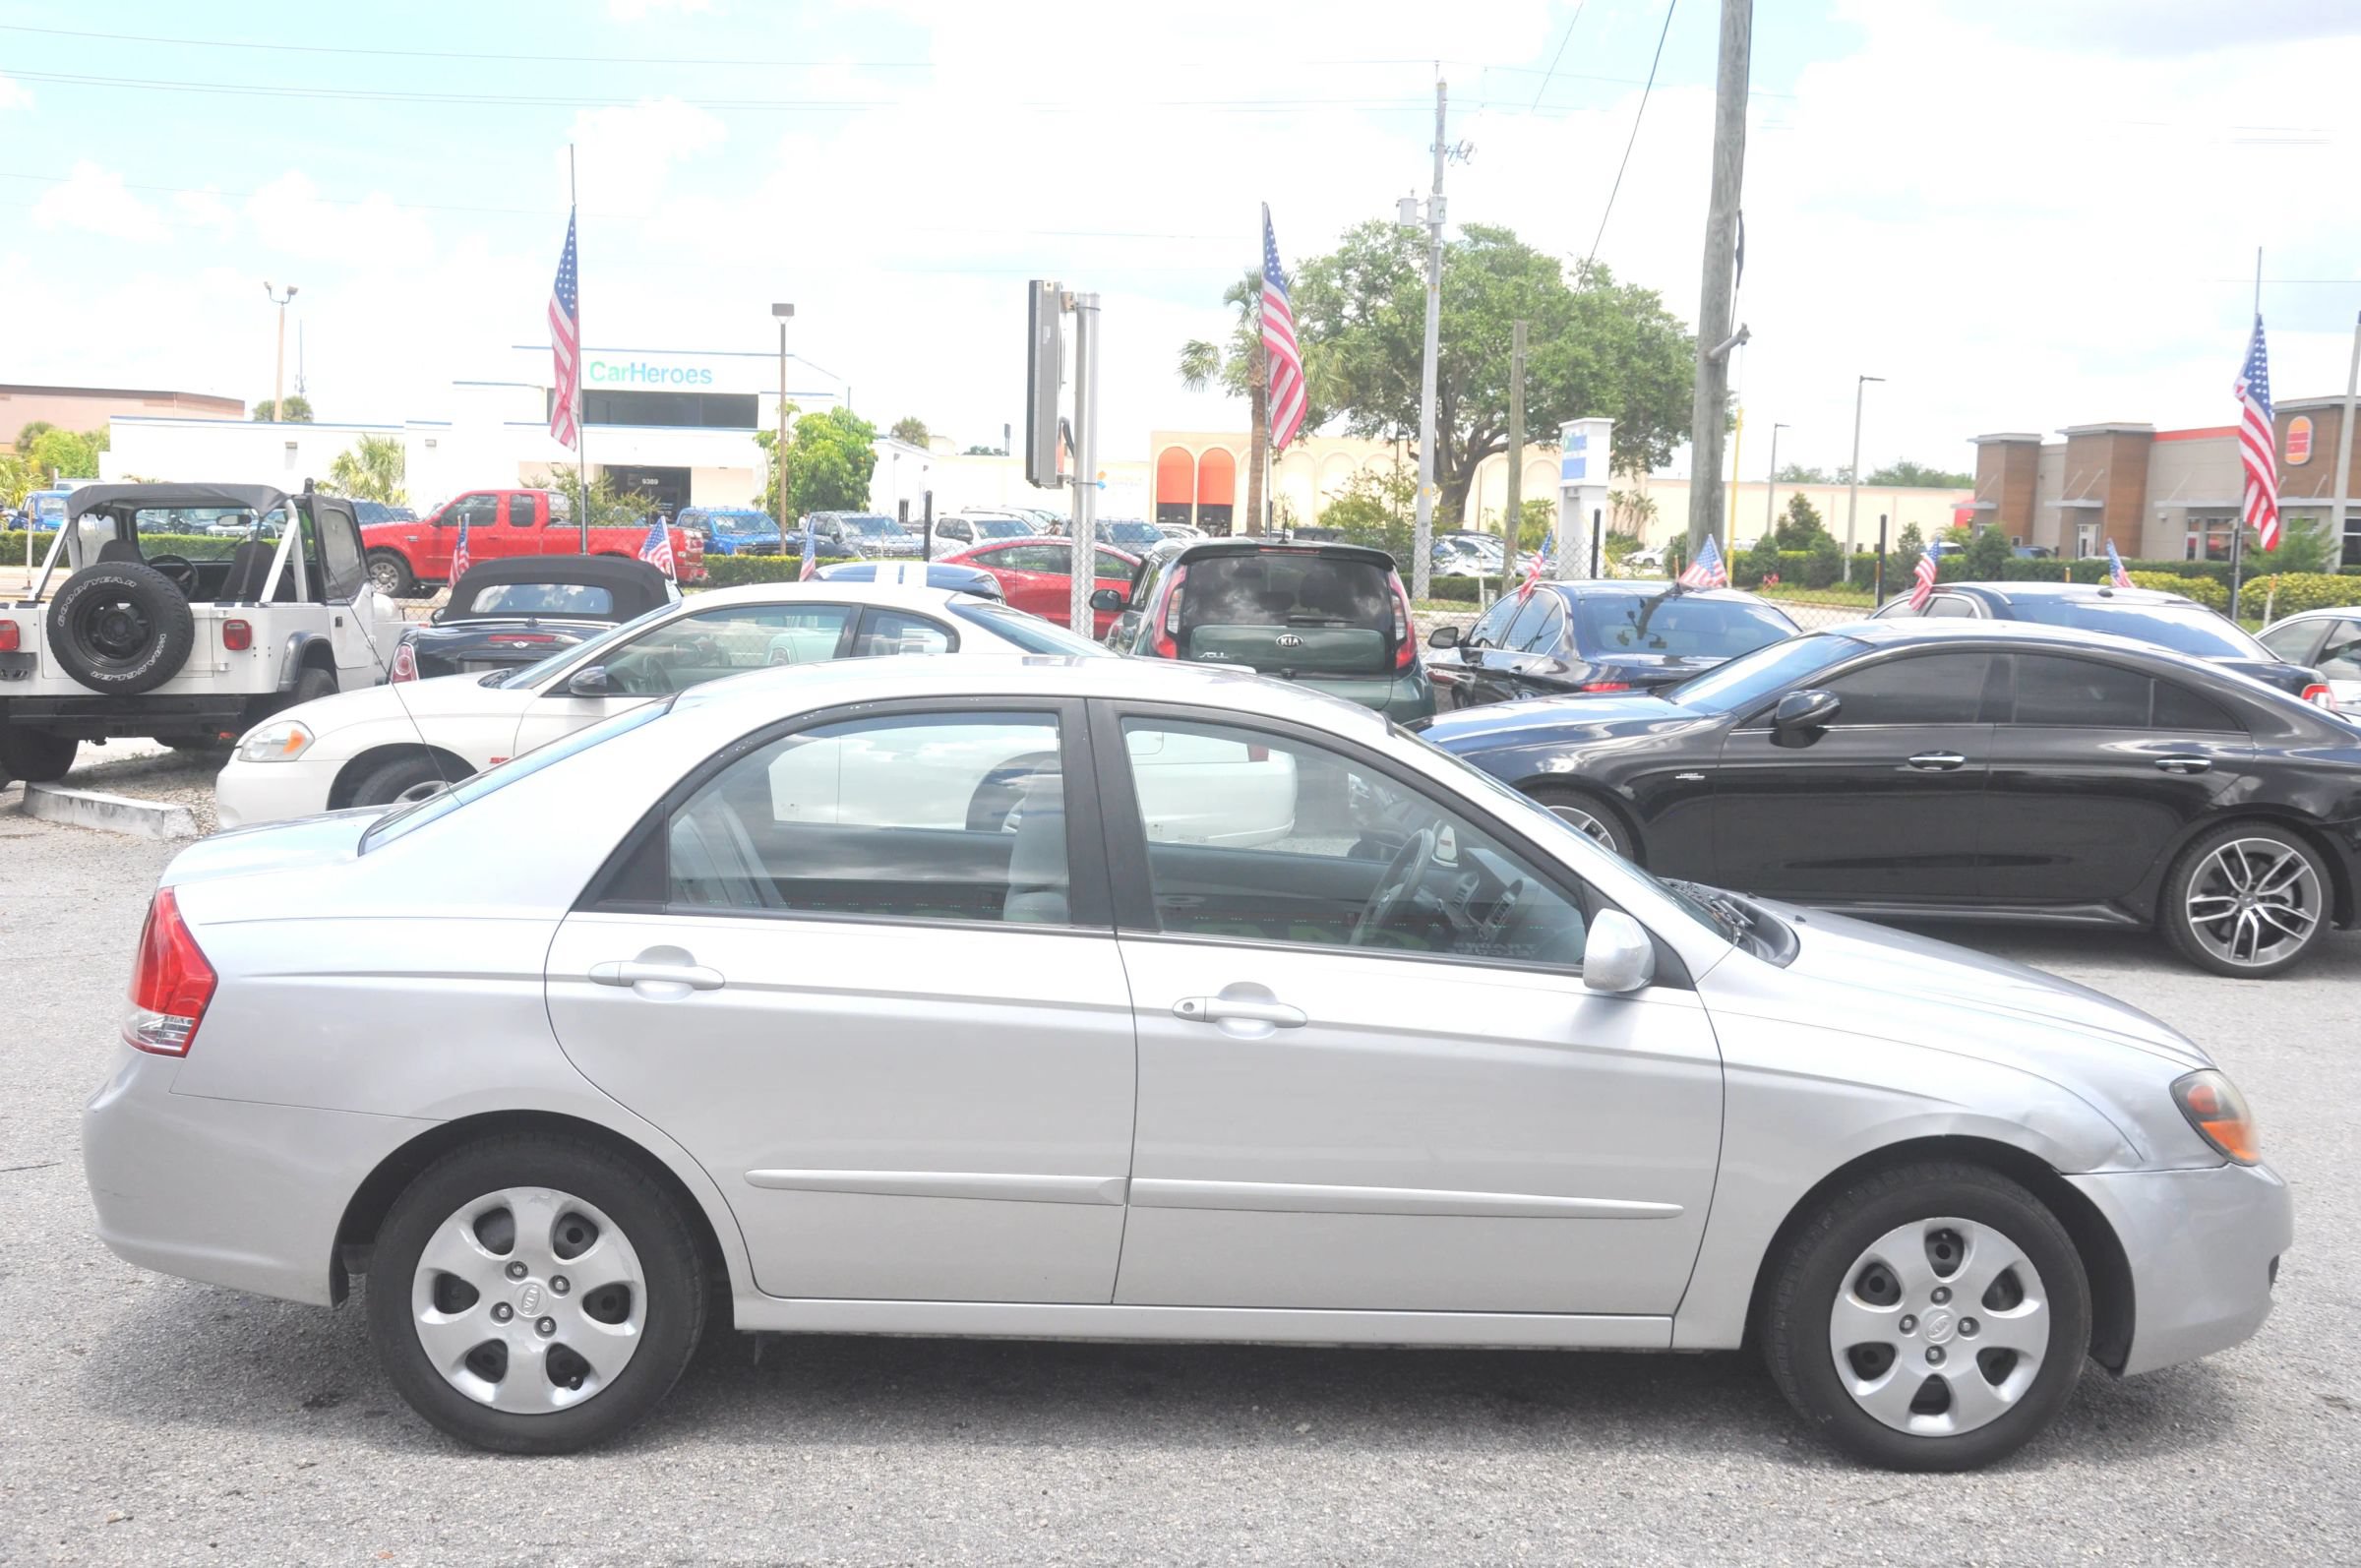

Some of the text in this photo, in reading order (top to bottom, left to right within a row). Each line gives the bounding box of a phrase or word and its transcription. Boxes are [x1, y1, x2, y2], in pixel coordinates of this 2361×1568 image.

[589, 361, 713, 385] CarHeroes
[1279, 635, 1301, 646] KIA
[90, 633, 167, 682] WRANGLER
